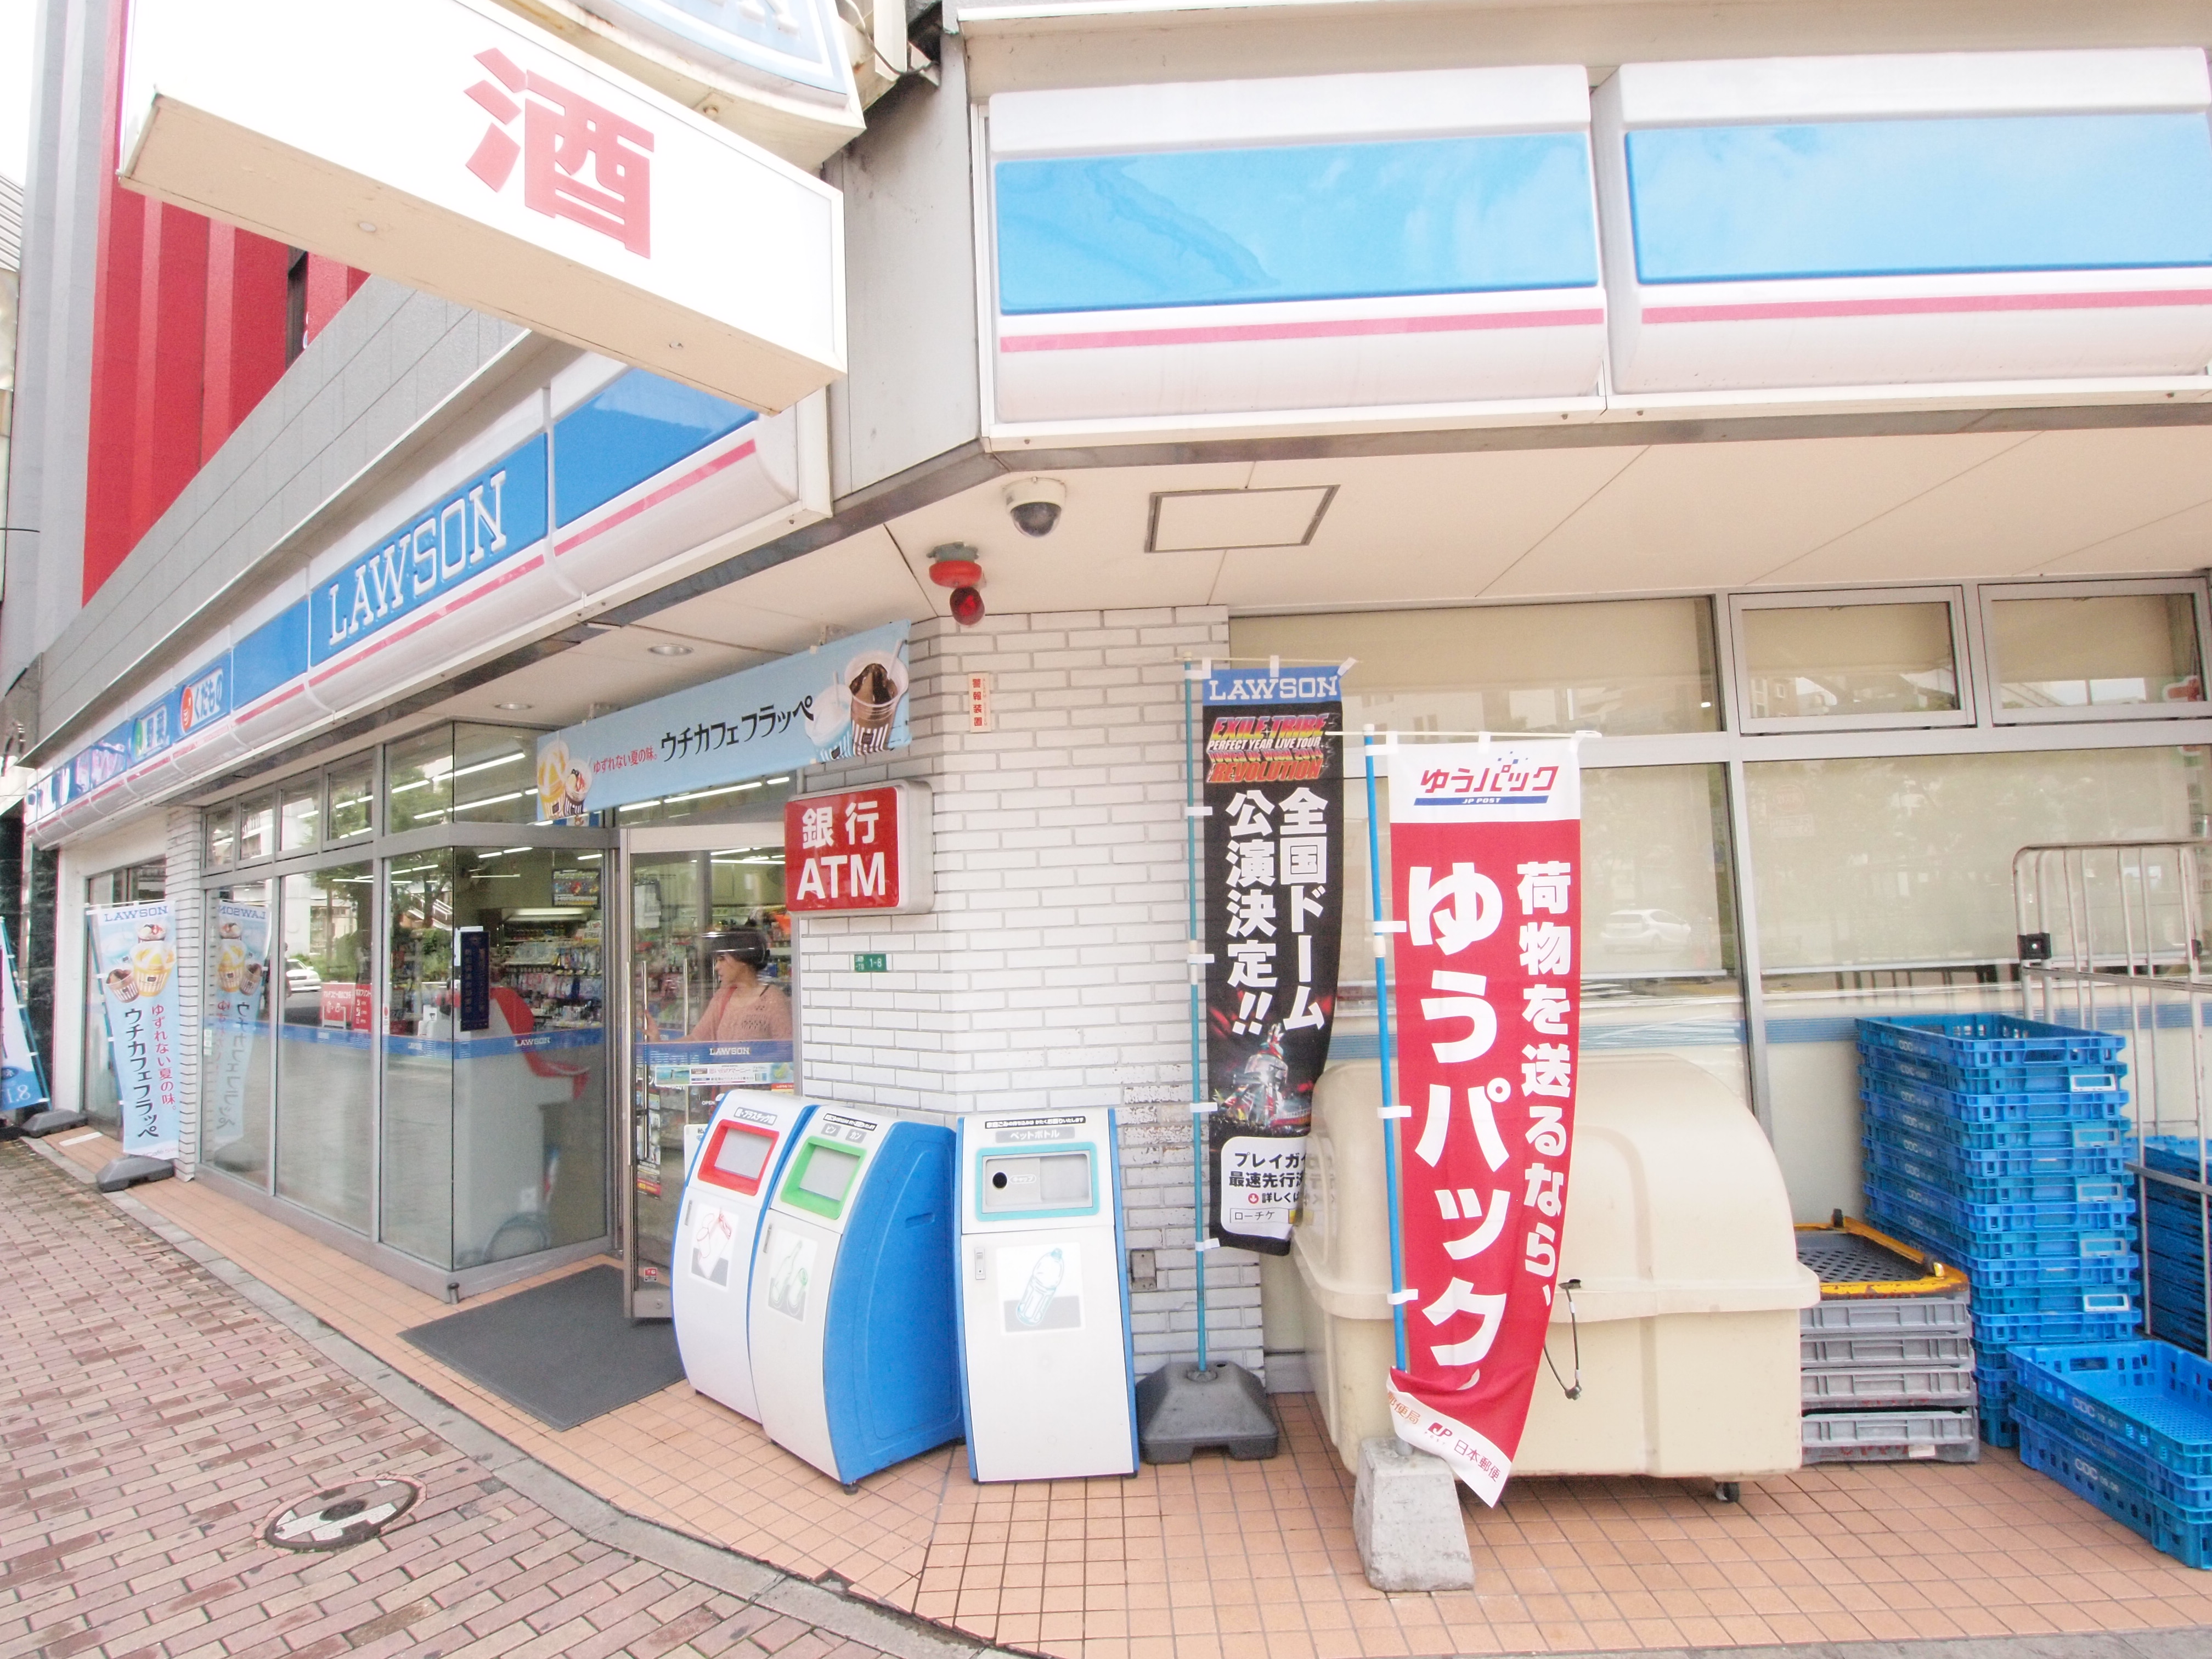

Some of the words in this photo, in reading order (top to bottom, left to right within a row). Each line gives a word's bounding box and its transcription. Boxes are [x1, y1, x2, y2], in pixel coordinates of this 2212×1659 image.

[464, 47, 654, 259] 酒
[329, 470, 506, 646] LAWSON
[195, 674, 223, 720] くだもの
[973, 678, 983, 726] 警報装置
[1209, 675, 1338, 701] LAWSON
[593, 746, 657, 775] ゆずれない夏の味。
[661, 695, 814, 763] ウチカフェフラッペ
[1210, 716, 1271, 740] EXILE
[1269, 713, 1329, 738] TRIBE
[1207, 738, 1248, 751] PERFECT
[1248, 738, 1273, 750] YEAR
[1274, 737, 1297, 749] LIVE
[1296, 736, 1322, 748] TOUR
[1210, 758, 1324, 783] REVOLUTION
[1420, 764, 1559, 793] ゆうパック
[802, 800, 879, 849] 銀行
[796, 851, 886, 900] ATM
[104, 905, 168, 922] LAWSON
[1279, 787, 1328, 1030] 全国ドーム
[869, 958, 882, 968] 1-8
[515, 1036, 551, 1047] LAWSON
[709, 1047, 751, 1056] LAWSON
[151, 1004, 176, 1110] ゆずれない夏の味。
[125, 1008, 159, 1138] ウチカフェフラッペ
[1516, 860, 1572, 1307] 荷物を送るなら、
[825, 1125, 837, 1134] ビン
[849, 1131, 862, 1140] カン
[1010, 1129, 1060, 1140] ペットボトル
[1234, 1210, 1276, 1221] ローチケ
[1387, 1391, 1421, 1425] 郵便局
[1427, 1422, 1453, 1437] JP
[1454, 1439, 1501, 1482] 日本郵便
[2075, 1458, 2098, 1481] CDC
